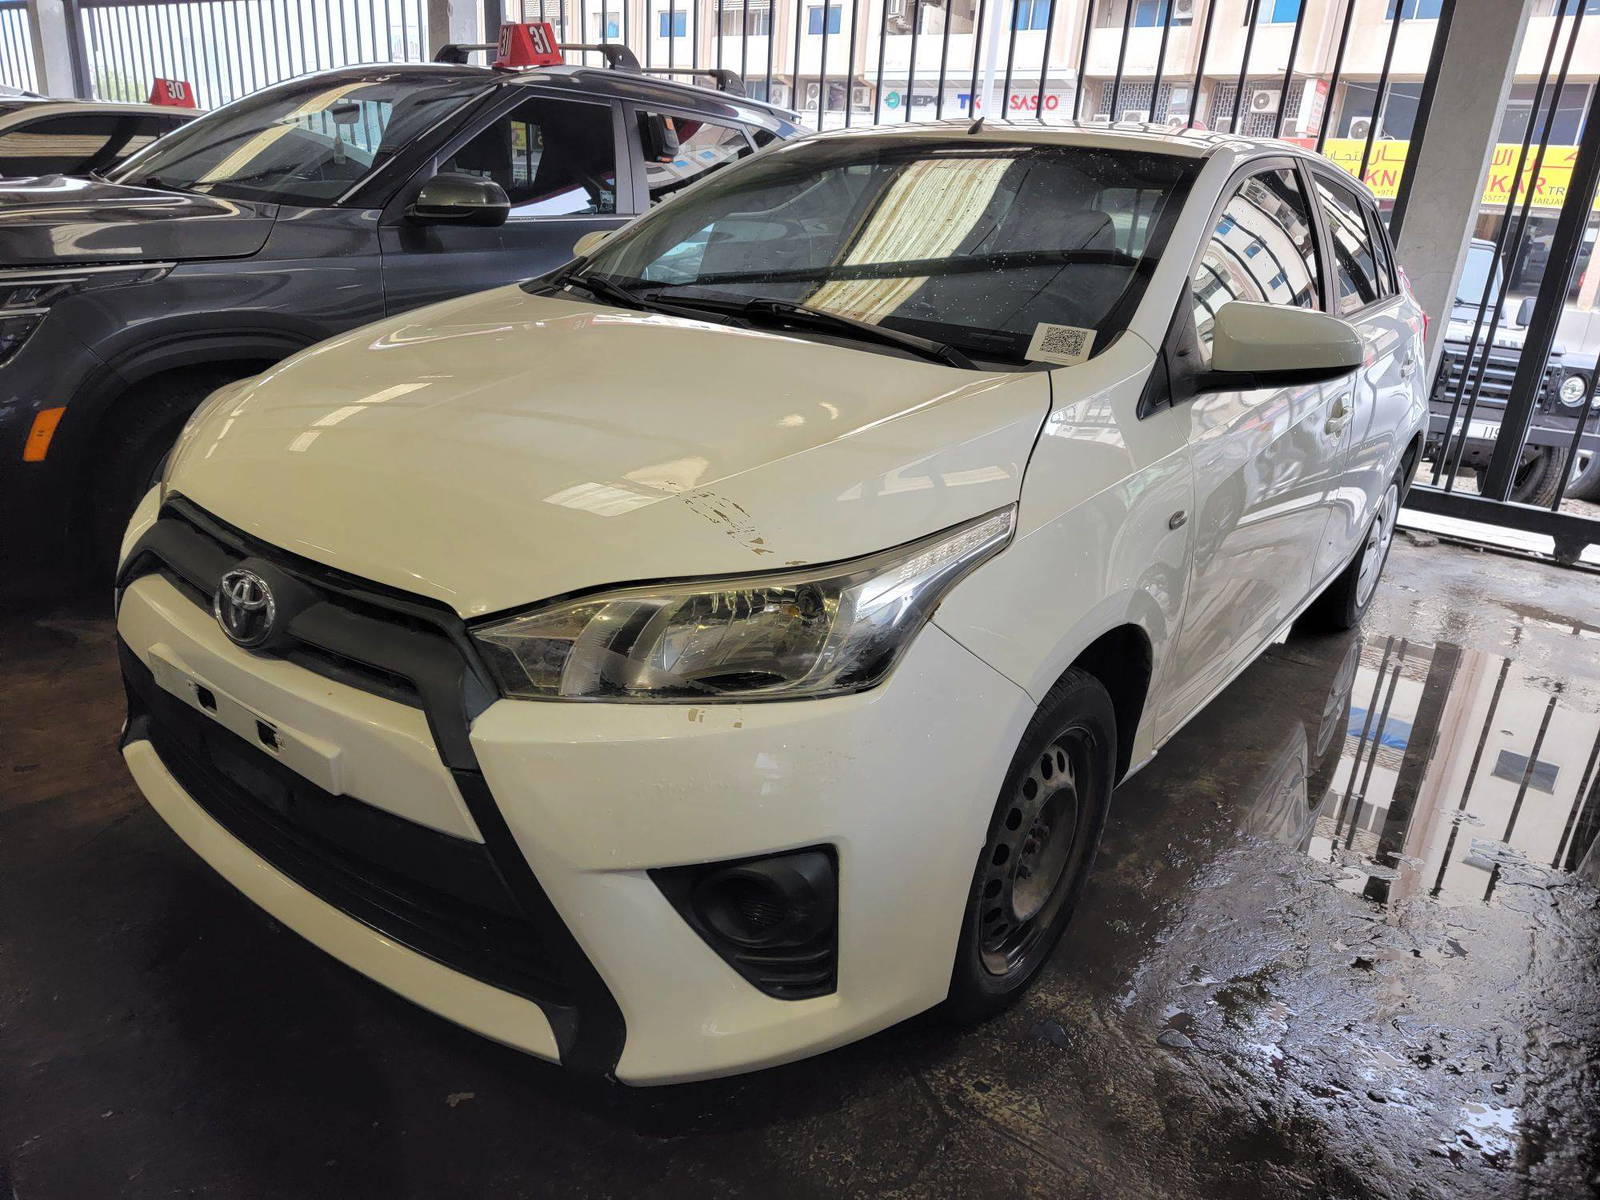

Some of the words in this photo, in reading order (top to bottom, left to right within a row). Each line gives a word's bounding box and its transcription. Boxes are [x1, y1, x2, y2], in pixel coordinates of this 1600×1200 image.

[500, 28, 510, 56] 31
[529, 25, 552, 54] 31
[166, 80, 185, 100] 30
[1010, 94, 1059, 111] SASO
[1548, 186, 1566, 196] TR
